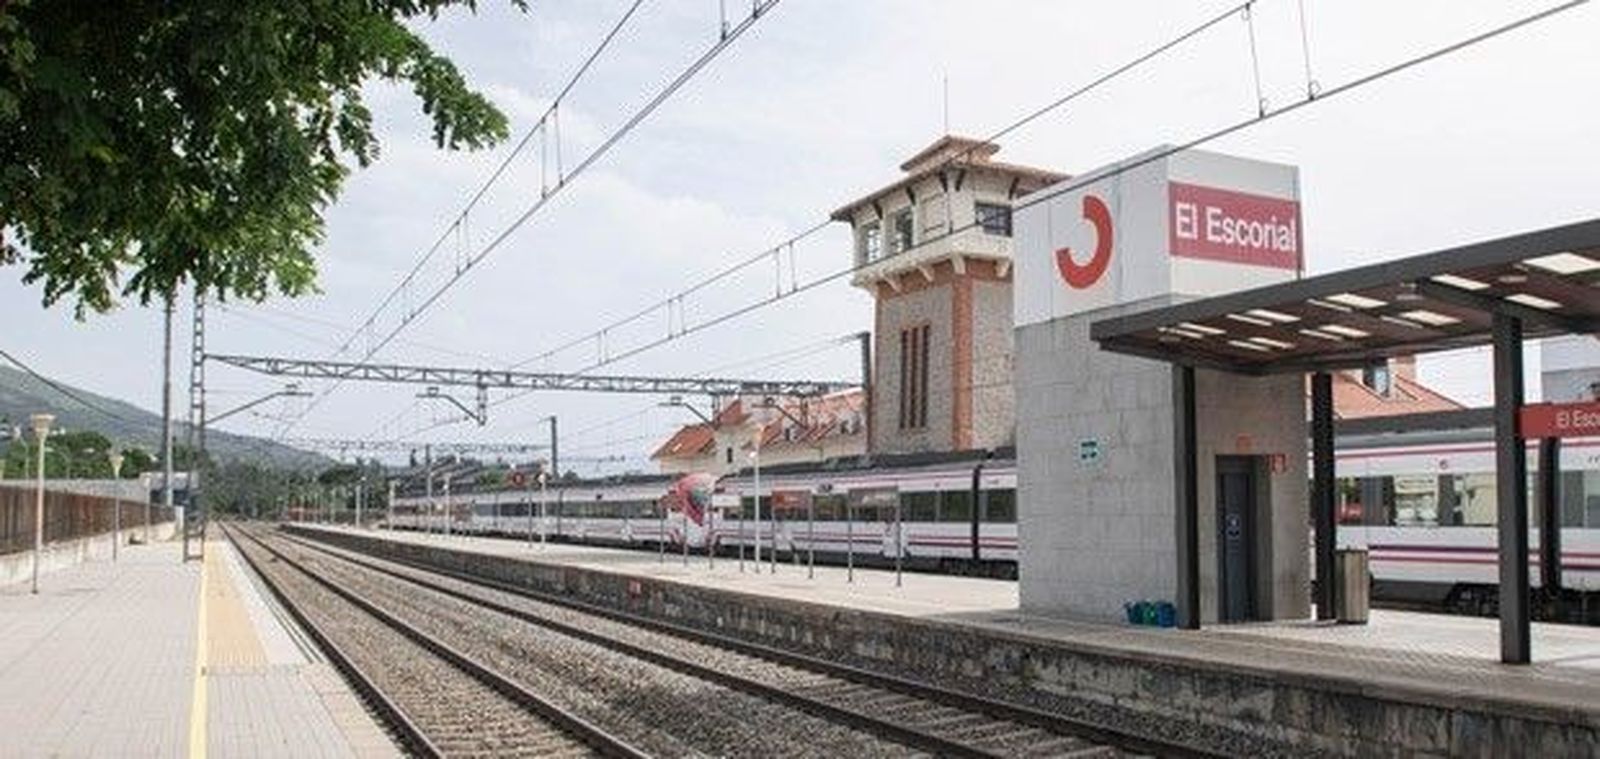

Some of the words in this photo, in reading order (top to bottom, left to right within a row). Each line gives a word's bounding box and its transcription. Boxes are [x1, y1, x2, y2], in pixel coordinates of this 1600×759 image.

[1176, 202, 1199, 240] El
[1207, 205, 1297, 253] Escorial
[1555, 409, 1570, 429] El
